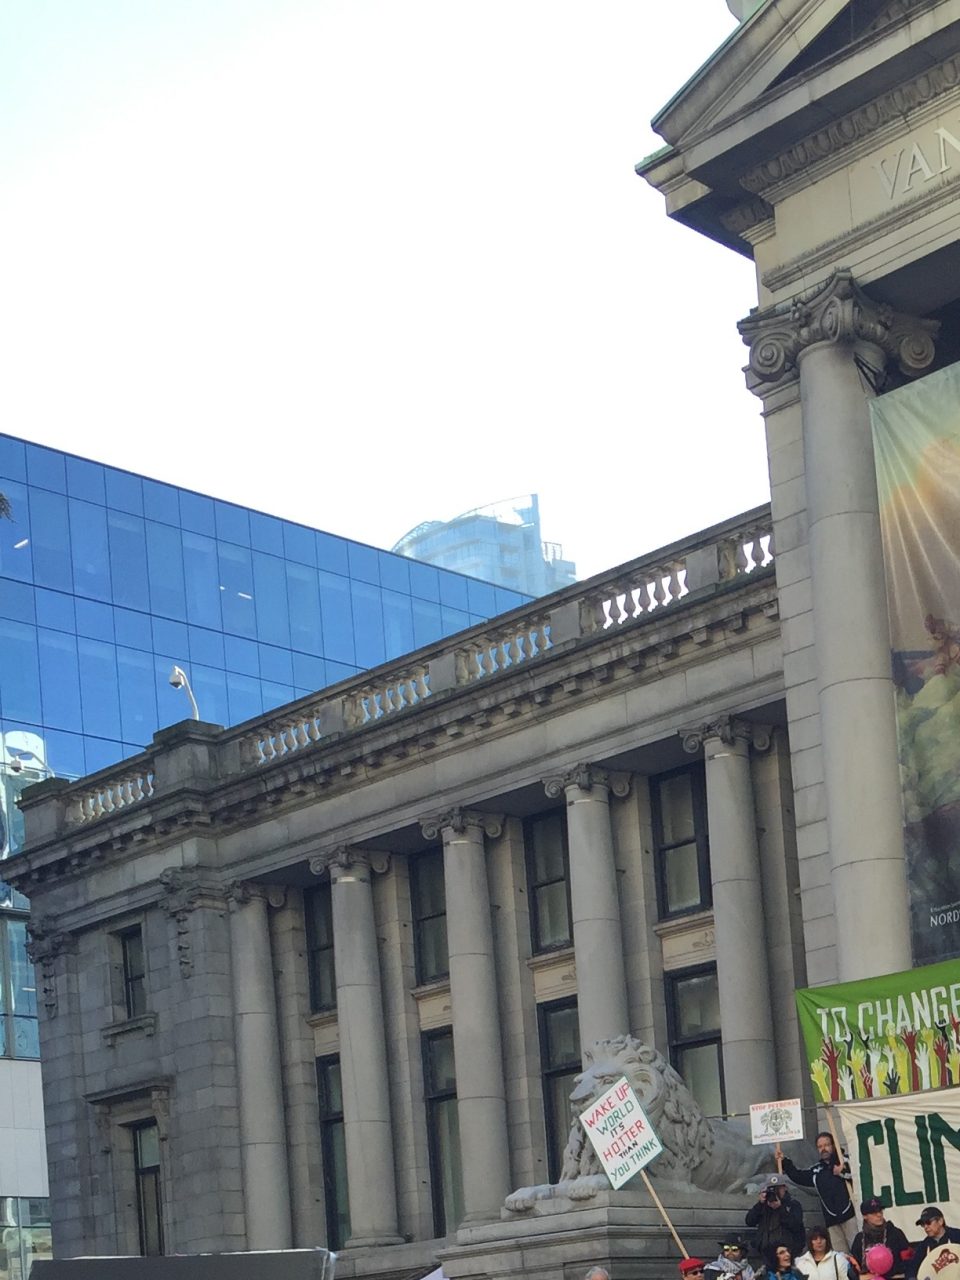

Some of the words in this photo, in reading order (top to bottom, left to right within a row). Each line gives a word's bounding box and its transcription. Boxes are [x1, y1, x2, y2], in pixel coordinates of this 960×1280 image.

[816, 1006, 850, 1042] TO
[585, 1096, 616, 1128] WAKE
[615, 1082, 630, 1102] UP
[596, 1100, 634, 1136] WORLD
[603, 1119, 646, 1162] HOTTER
[611, 1161, 631, 1181] YOU
[630, 1138, 658, 1165] THINK
[618, 1140, 639, 1159] THAN
